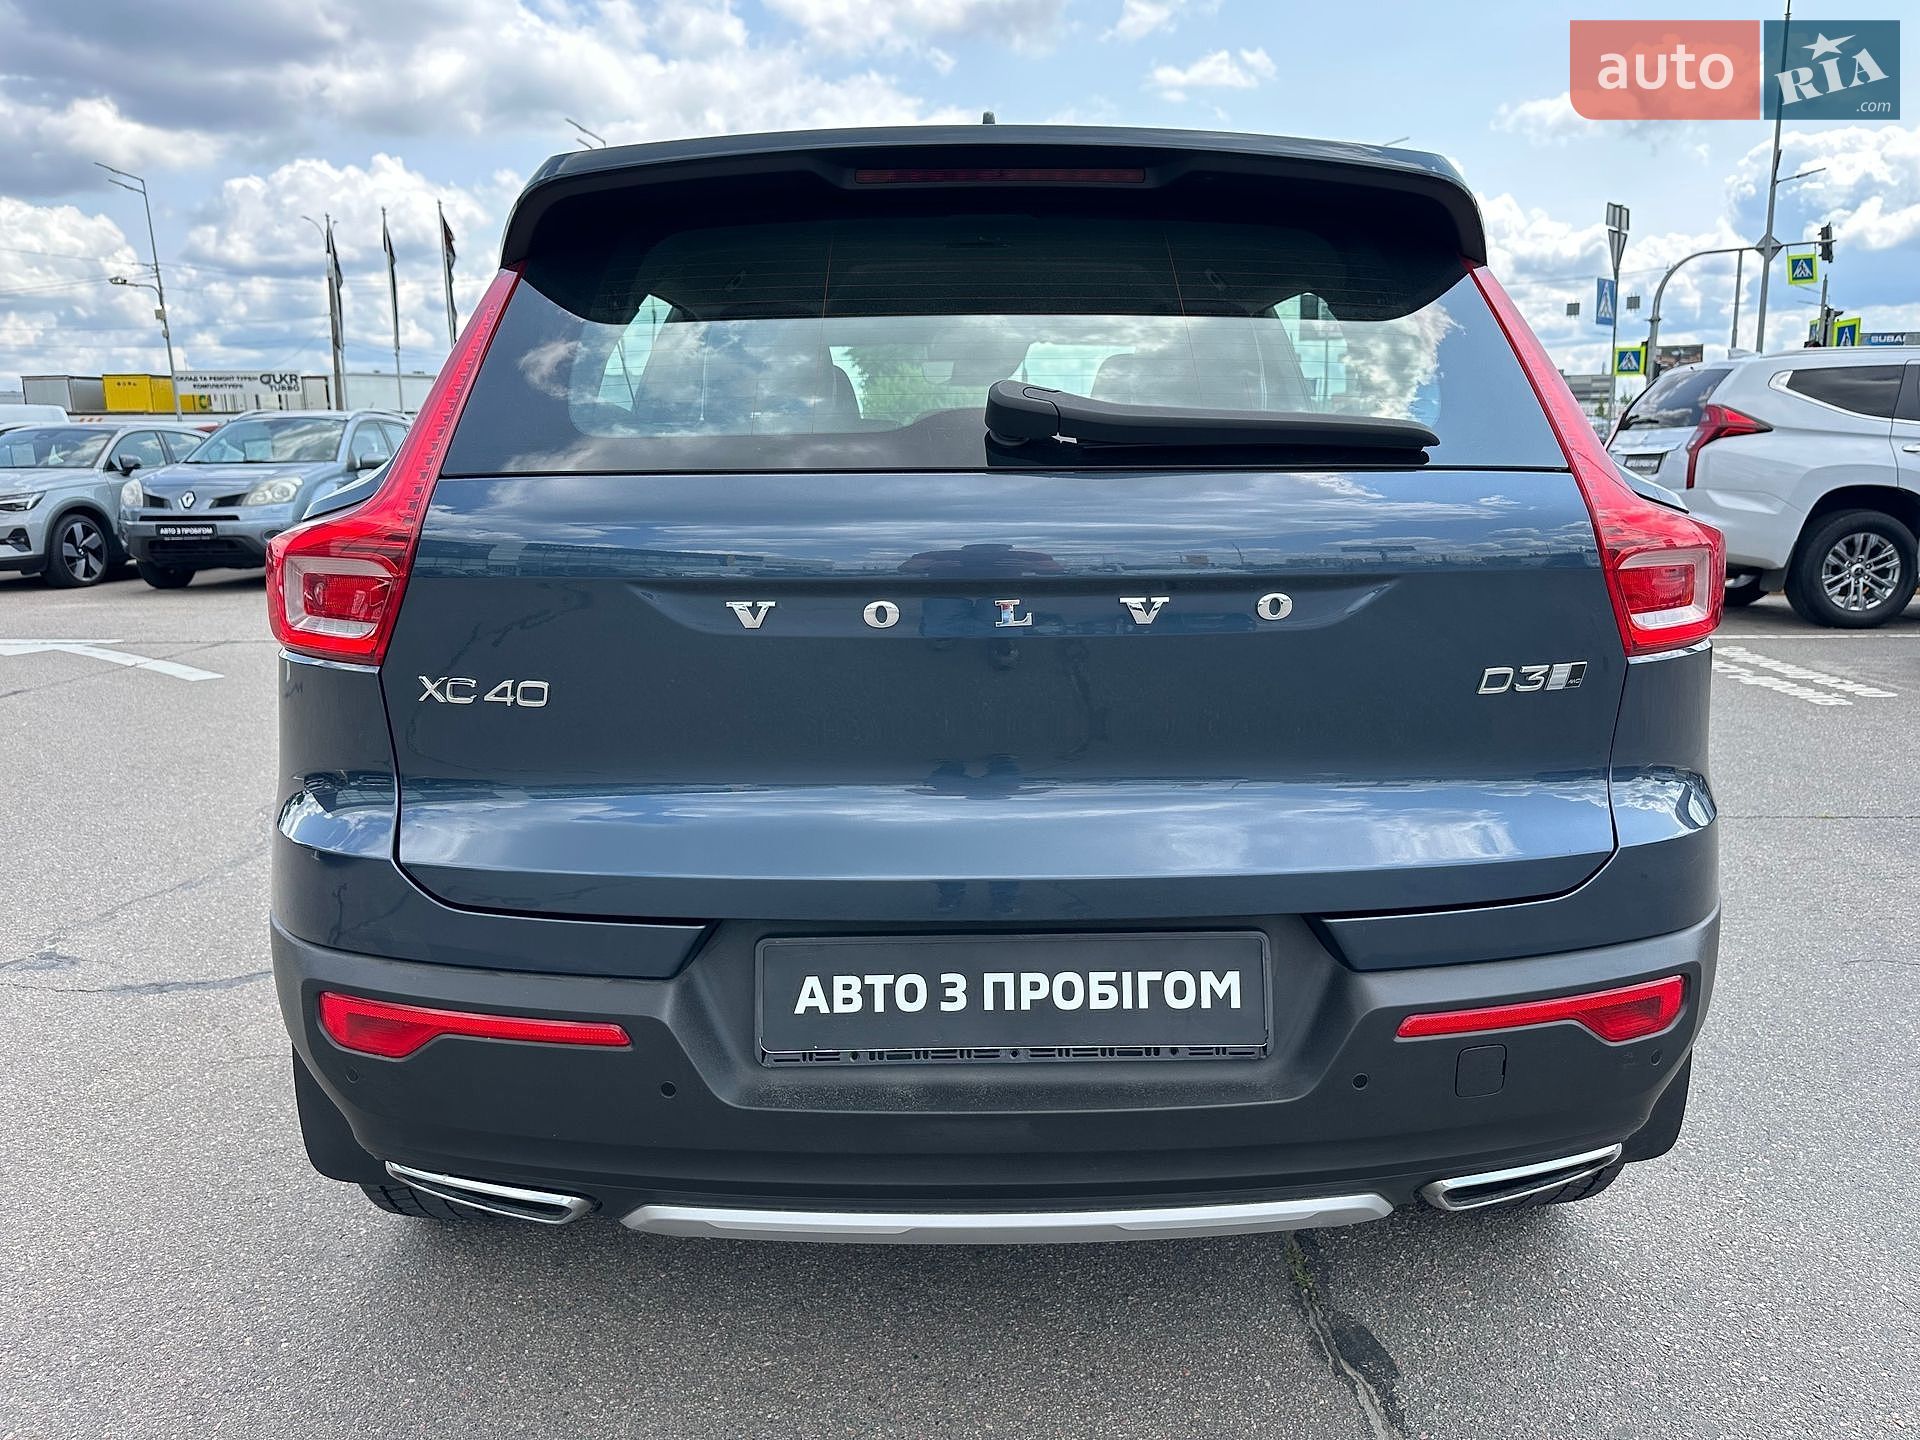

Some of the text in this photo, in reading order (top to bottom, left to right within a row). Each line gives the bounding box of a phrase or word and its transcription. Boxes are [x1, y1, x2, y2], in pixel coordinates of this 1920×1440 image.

[725, 592, 1294, 630] VOLVO
[1477, 664, 1549, 695] D3
[794, 970, 1242, 1014] АВТО З ПРОБІГОМ
